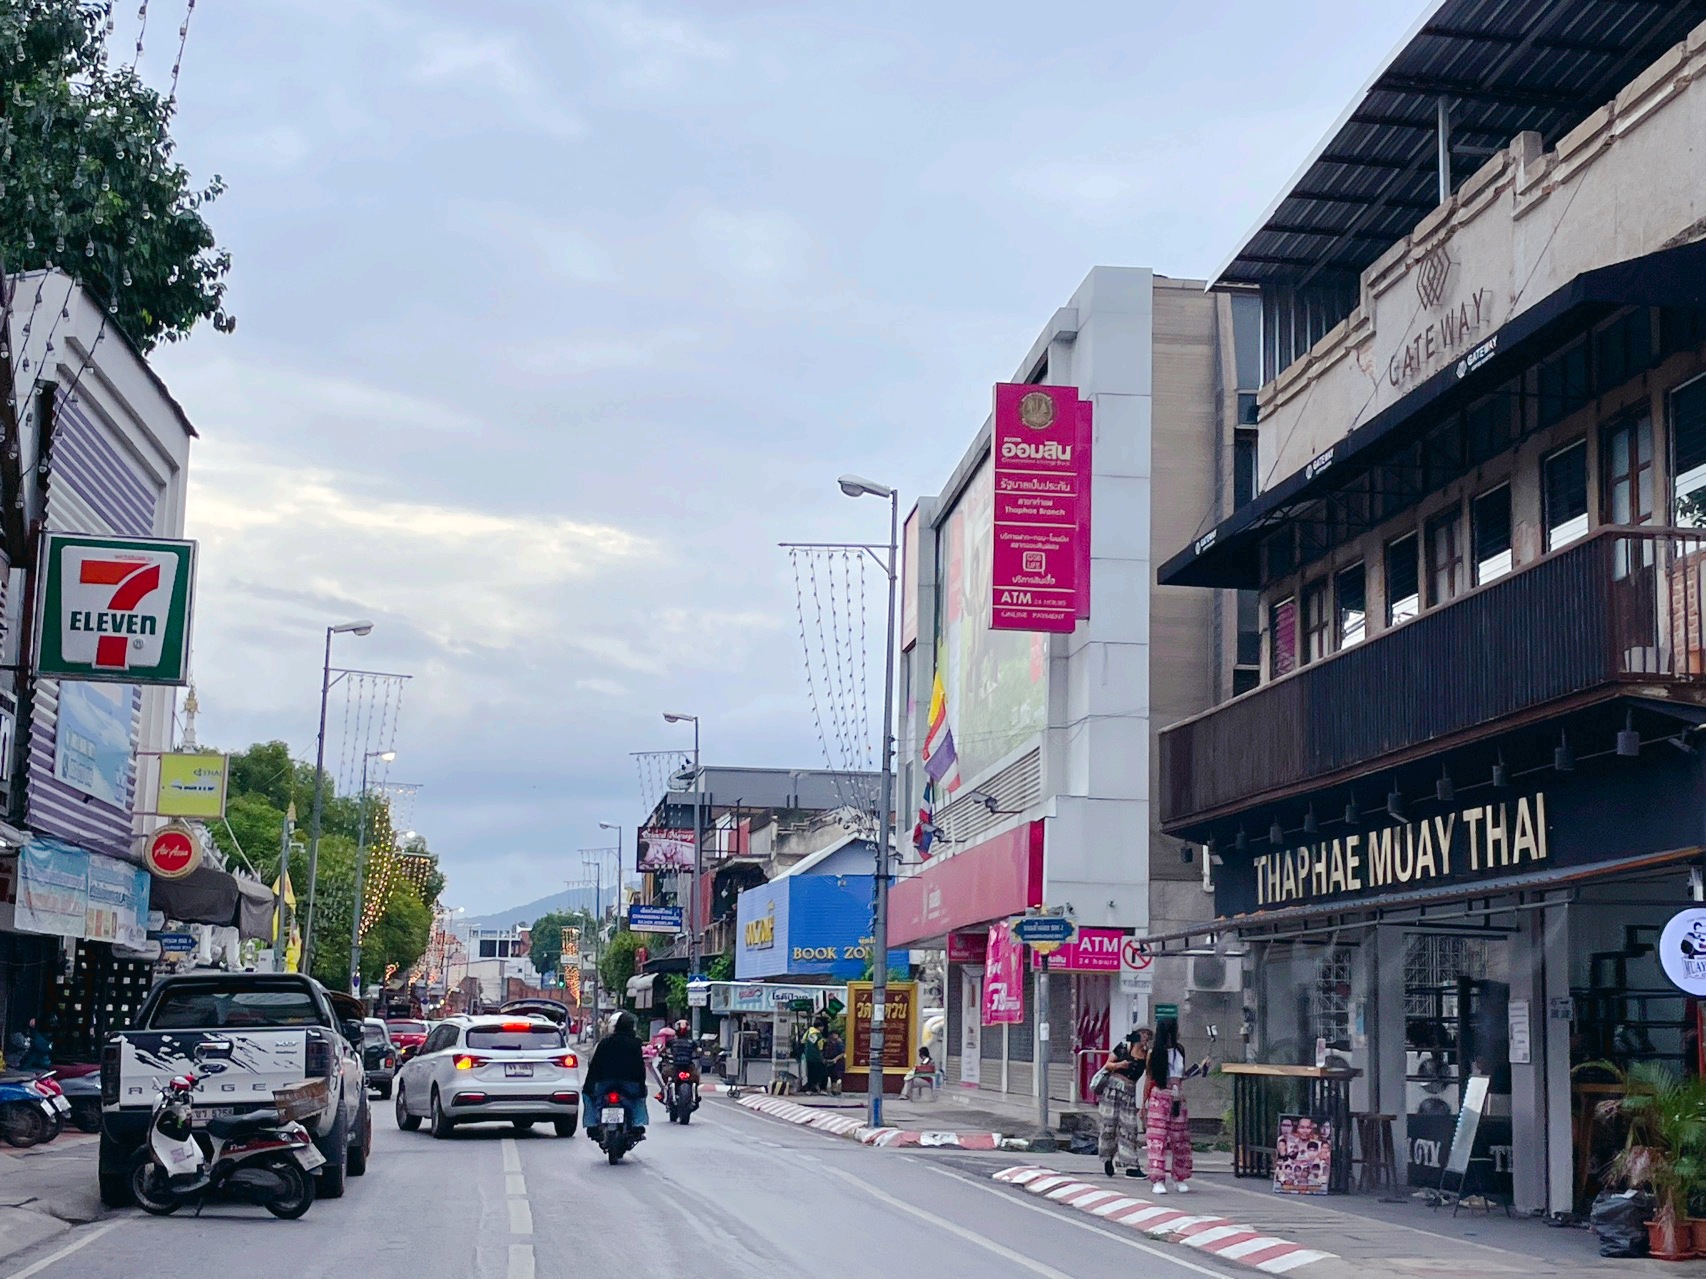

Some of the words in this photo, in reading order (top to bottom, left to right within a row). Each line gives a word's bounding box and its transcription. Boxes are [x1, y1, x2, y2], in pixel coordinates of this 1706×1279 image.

[1389, 287, 1484, 387] GATEWAY
[1002, 441, 1072, 460] ออมสิน
[1001, 591, 1032, 604] ATM
[1254, 838, 1362, 905] THAPHAE
[1368, 812, 1455, 887] MUAY
[1463, 792, 1547, 871] THAI
[793, 946, 838, 960] BOOK
[1079, 937, 1118, 953] ATM
